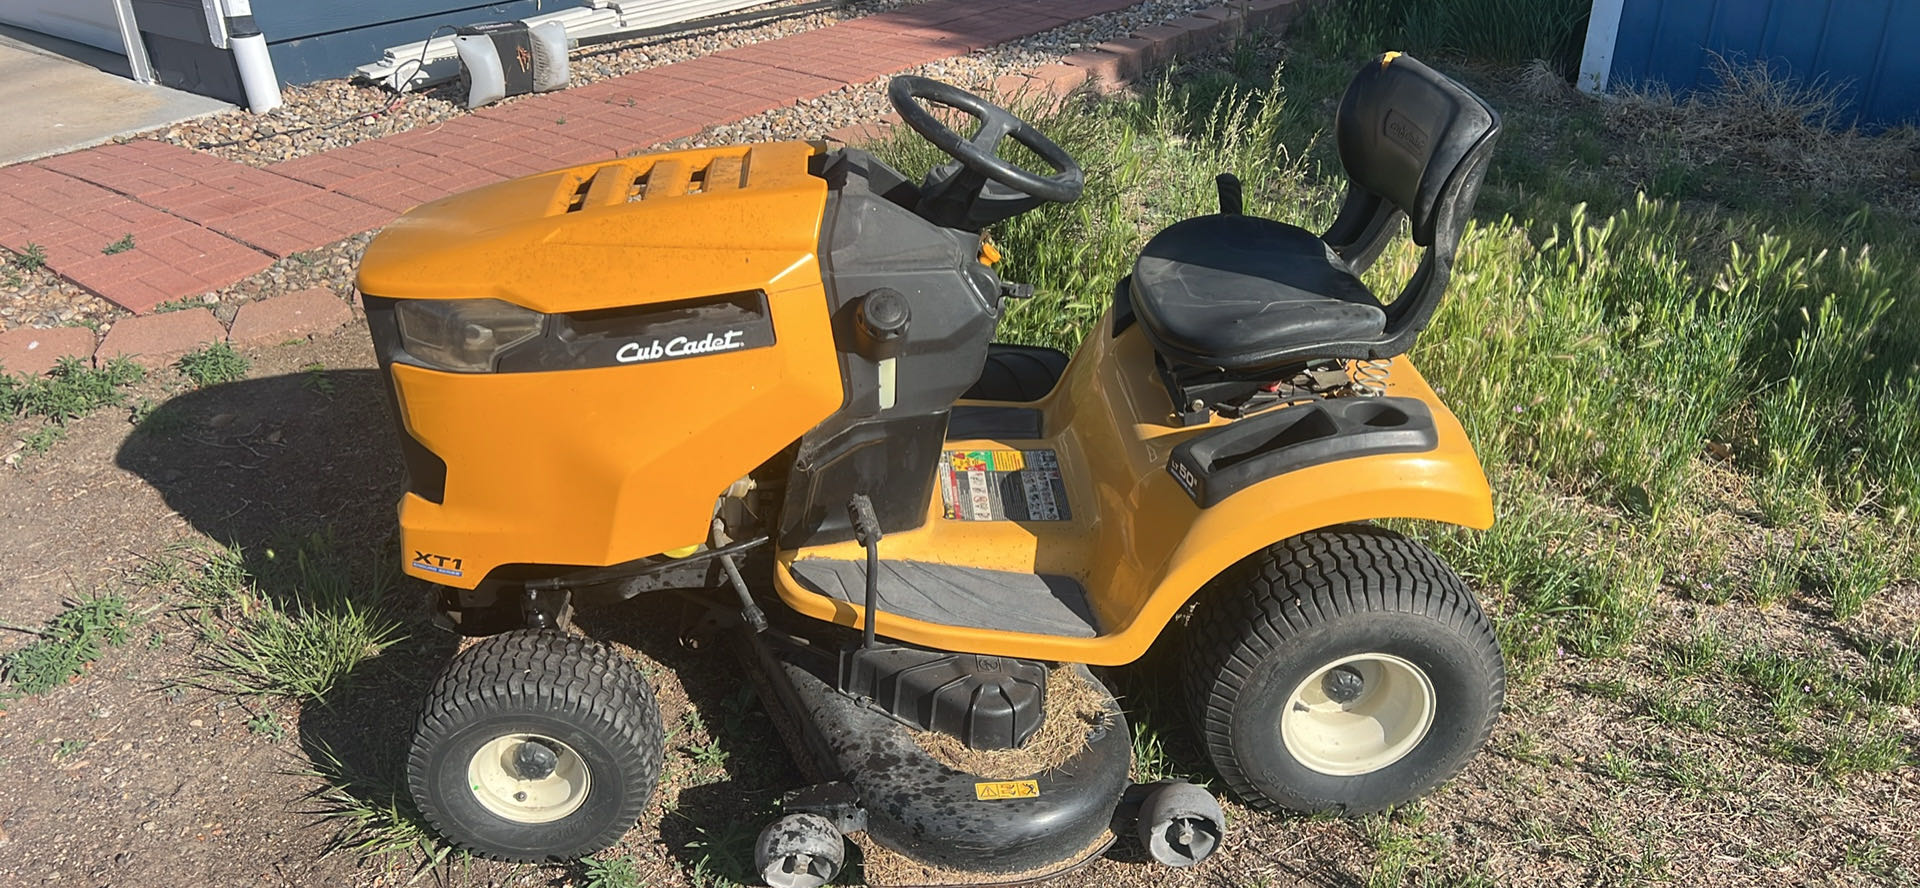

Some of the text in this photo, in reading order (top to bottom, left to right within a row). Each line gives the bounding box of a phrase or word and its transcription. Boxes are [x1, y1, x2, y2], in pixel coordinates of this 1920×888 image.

[616, 330, 743, 363] Cub Cadet
[1171, 460, 1179, 471] LT
[413, 550, 462, 570] XT1
